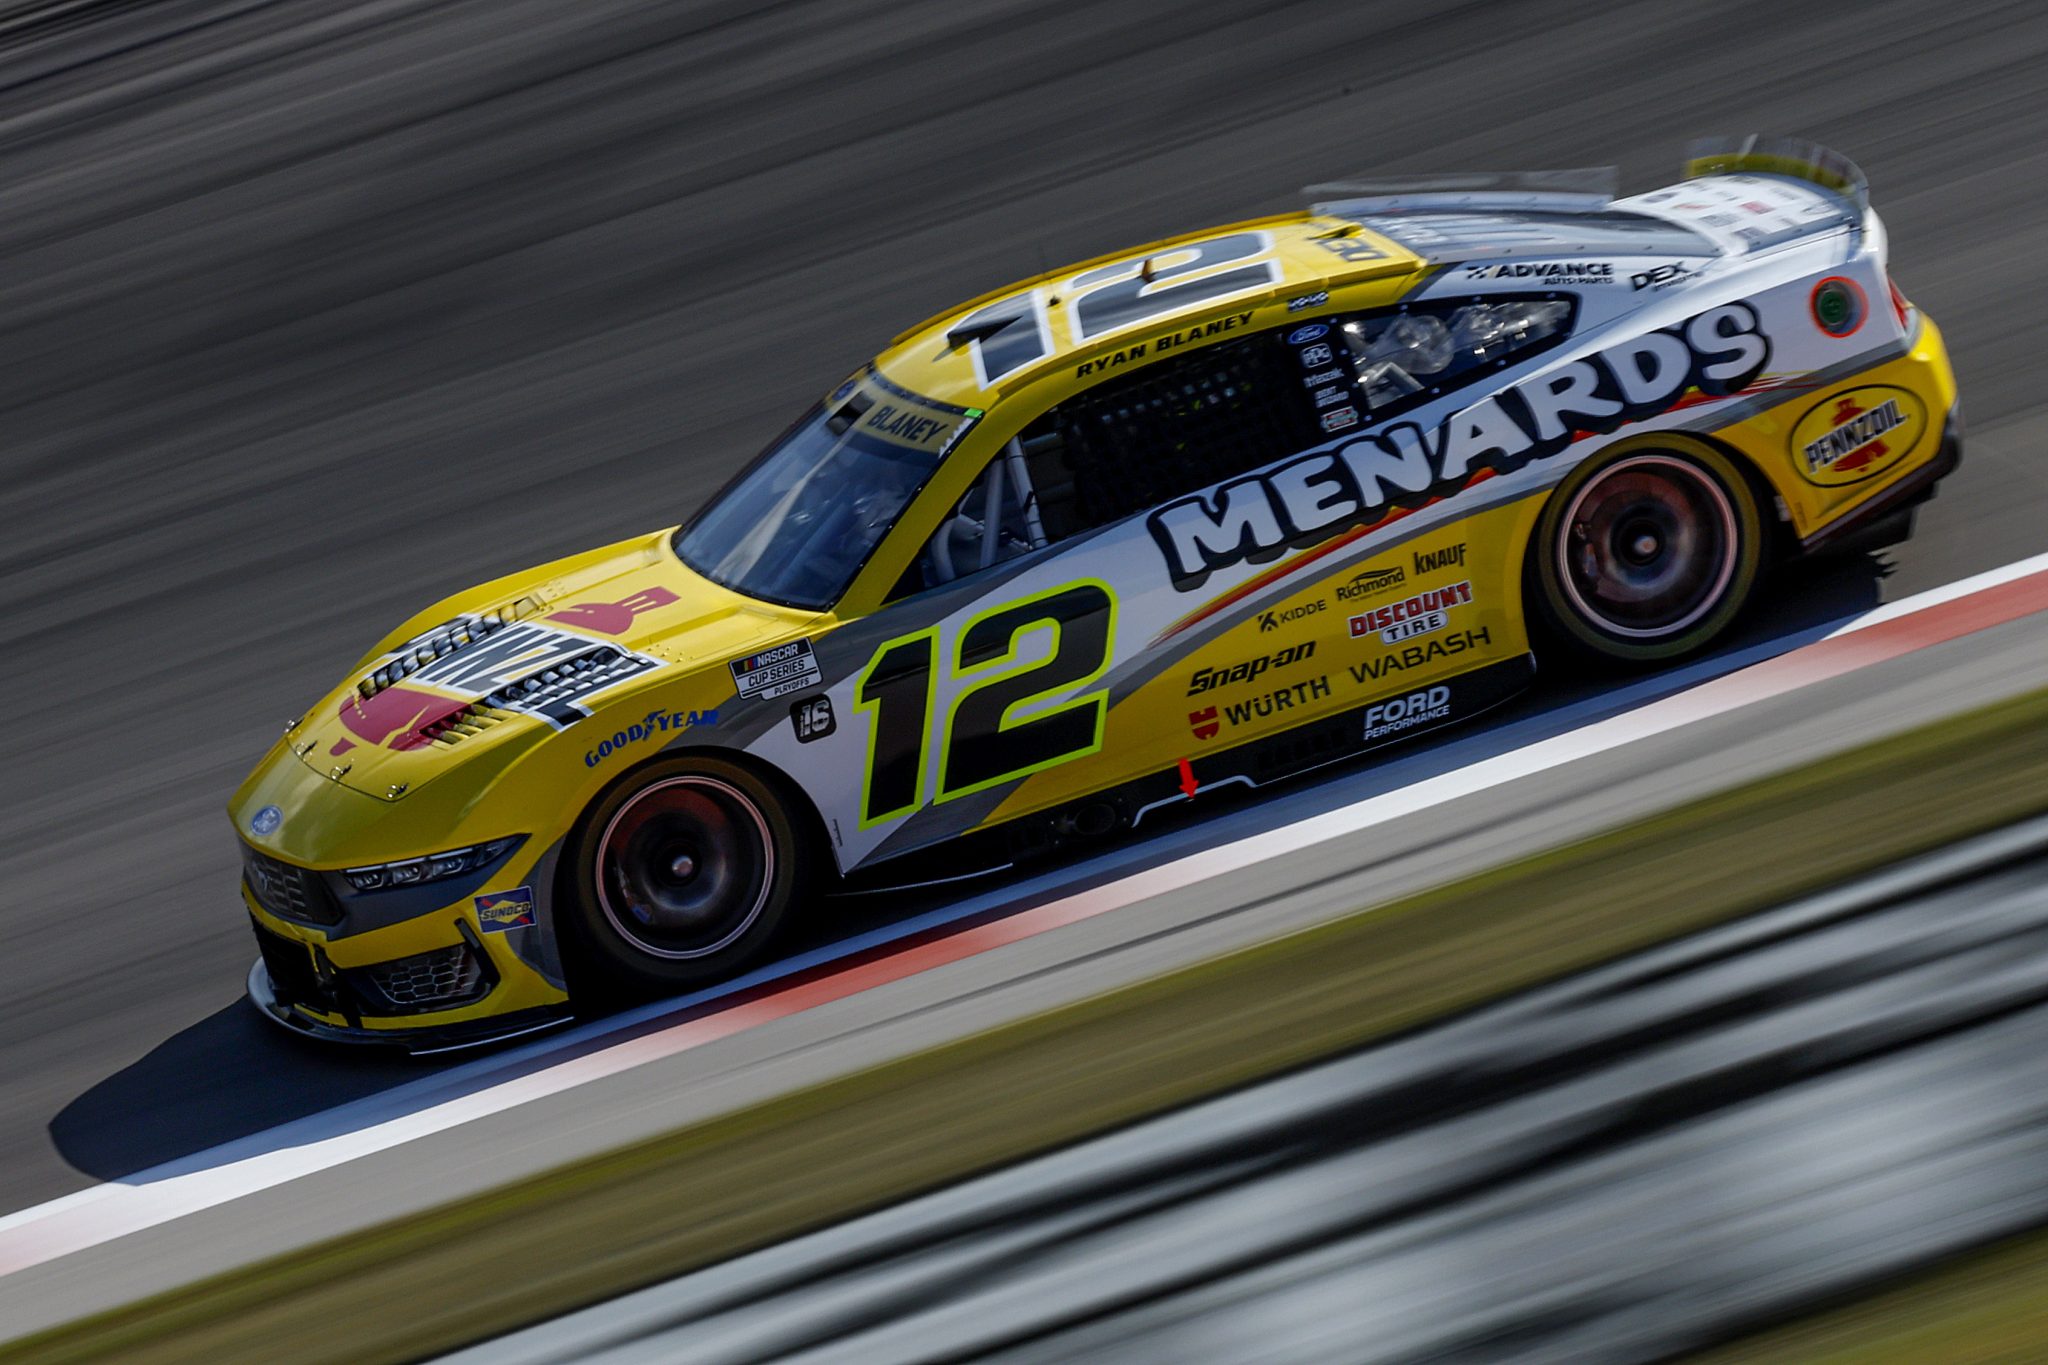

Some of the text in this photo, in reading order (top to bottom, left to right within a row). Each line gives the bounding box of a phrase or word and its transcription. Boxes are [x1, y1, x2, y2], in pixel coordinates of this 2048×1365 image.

[1496, 263, 1614, 278] ADVANCE
[1630, 261, 1690, 292] DEX
[944, 230, 1284, 391] 12
[1076, 311, 1254, 379] RYAN BLANEY
[867, 405, 949, 444] BLANEY
[1803, 398, 1907, 474] PENNZOIL
[1149, 303, 1769, 590] MENARDS
[1413, 543, 1467, 576] KNAUF
[1336, 566, 1405, 600] Richmond
[1280, 599, 1327, 624] KIDDE
[1349, 581, 1472, 638] DISCOUNT
[1386, 614, 1441, 641] TIRE
[748, 660, 805, 688] CUP SERIES
[757, 643, 799, 667] NASCAR
[1186, 640, 1317, 698] Snap-on
[1348, 626, 1492, 684] WABASH
[774, 677, 810, 696] PLAYOFFS
[853, 577, 1119, 832] 12
[1224, 674, 1332, 726] WÜRTH
[1363, 704, 1451, 741] PERFORMANCE
[1364, 685, 1451, 730] FORD
[584, 707, 720, 769] GOODYEAR
[481, 902, 531, 921] SUNOCO
